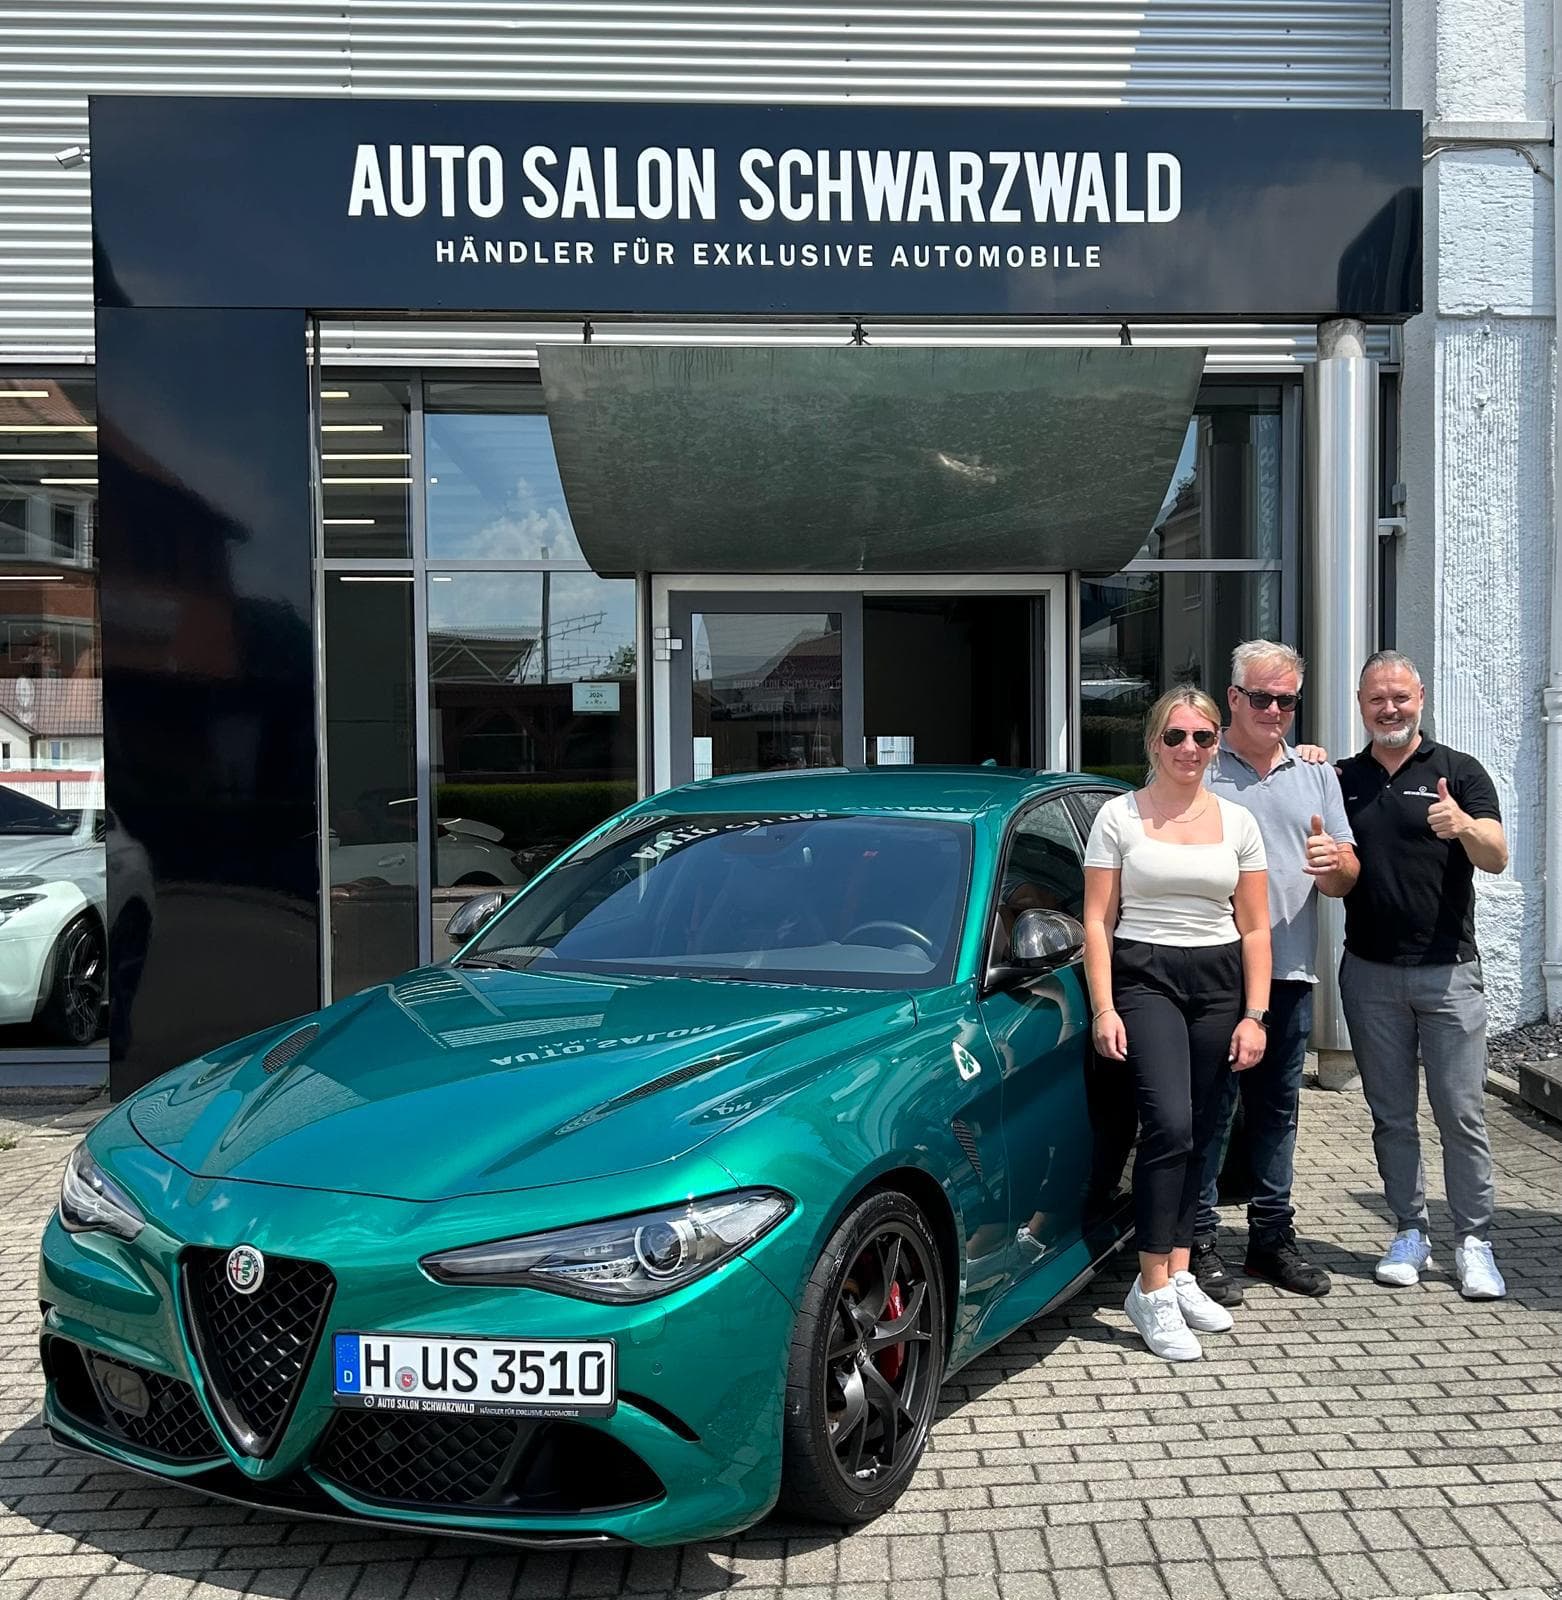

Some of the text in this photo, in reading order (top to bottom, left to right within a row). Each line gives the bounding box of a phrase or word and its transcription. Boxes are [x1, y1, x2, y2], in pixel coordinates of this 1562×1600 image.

[348, 144, 1182, 223] AUTO SALON SCHWARZWALD
[436, 236, 1101, 268] HÄNDLER FÜR EXKLUSIVE AUTOMOBILE
[344, 1370, 353, 1383] D
[364, 1343, 605, 1397] H US 3510
[377, 1398, 396, 1409] AUTO
[397, 1399, 419, 1411] SALON
[422, 1400, 475, 1413] SCHWARZWALD
